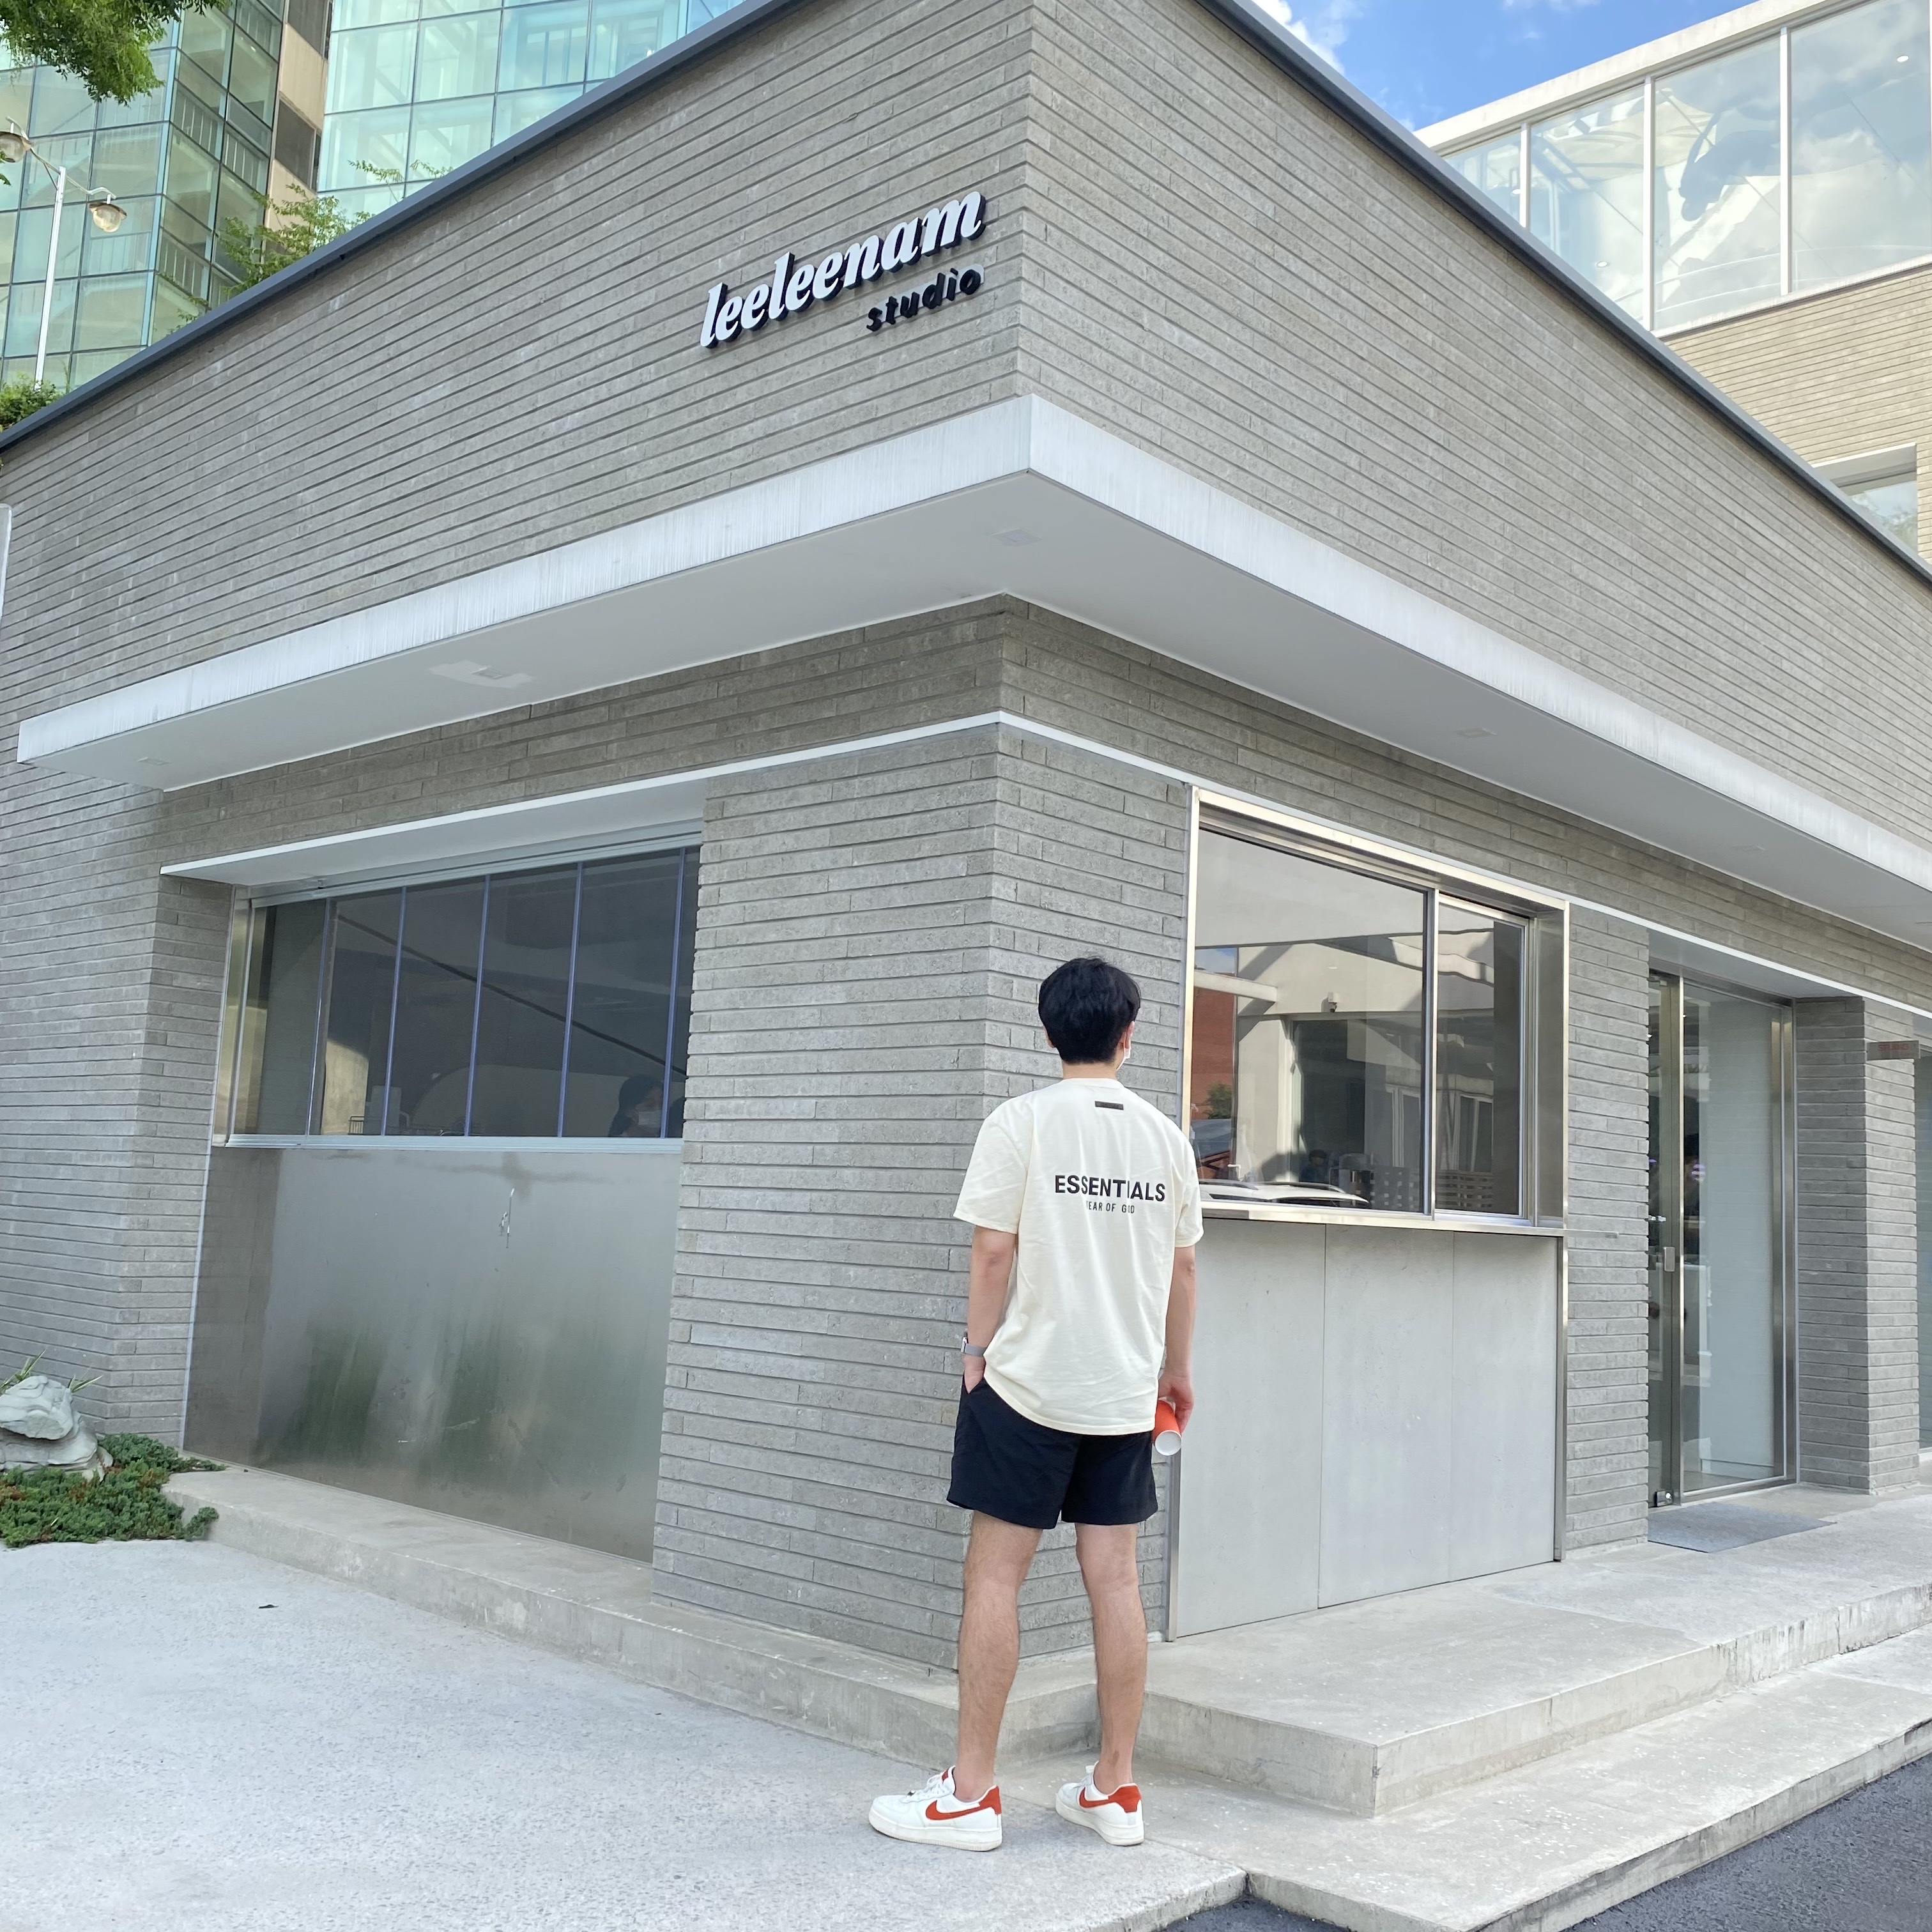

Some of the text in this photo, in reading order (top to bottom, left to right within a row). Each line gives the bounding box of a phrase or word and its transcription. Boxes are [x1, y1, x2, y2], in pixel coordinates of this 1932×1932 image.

[700, 191, 985, 348] leeleenam
[866, 268, 981, 332] studio
[1055, 1175, 1165, 1202] ESSENTIALS
[1106, 1202, 1116, 1213] OF
